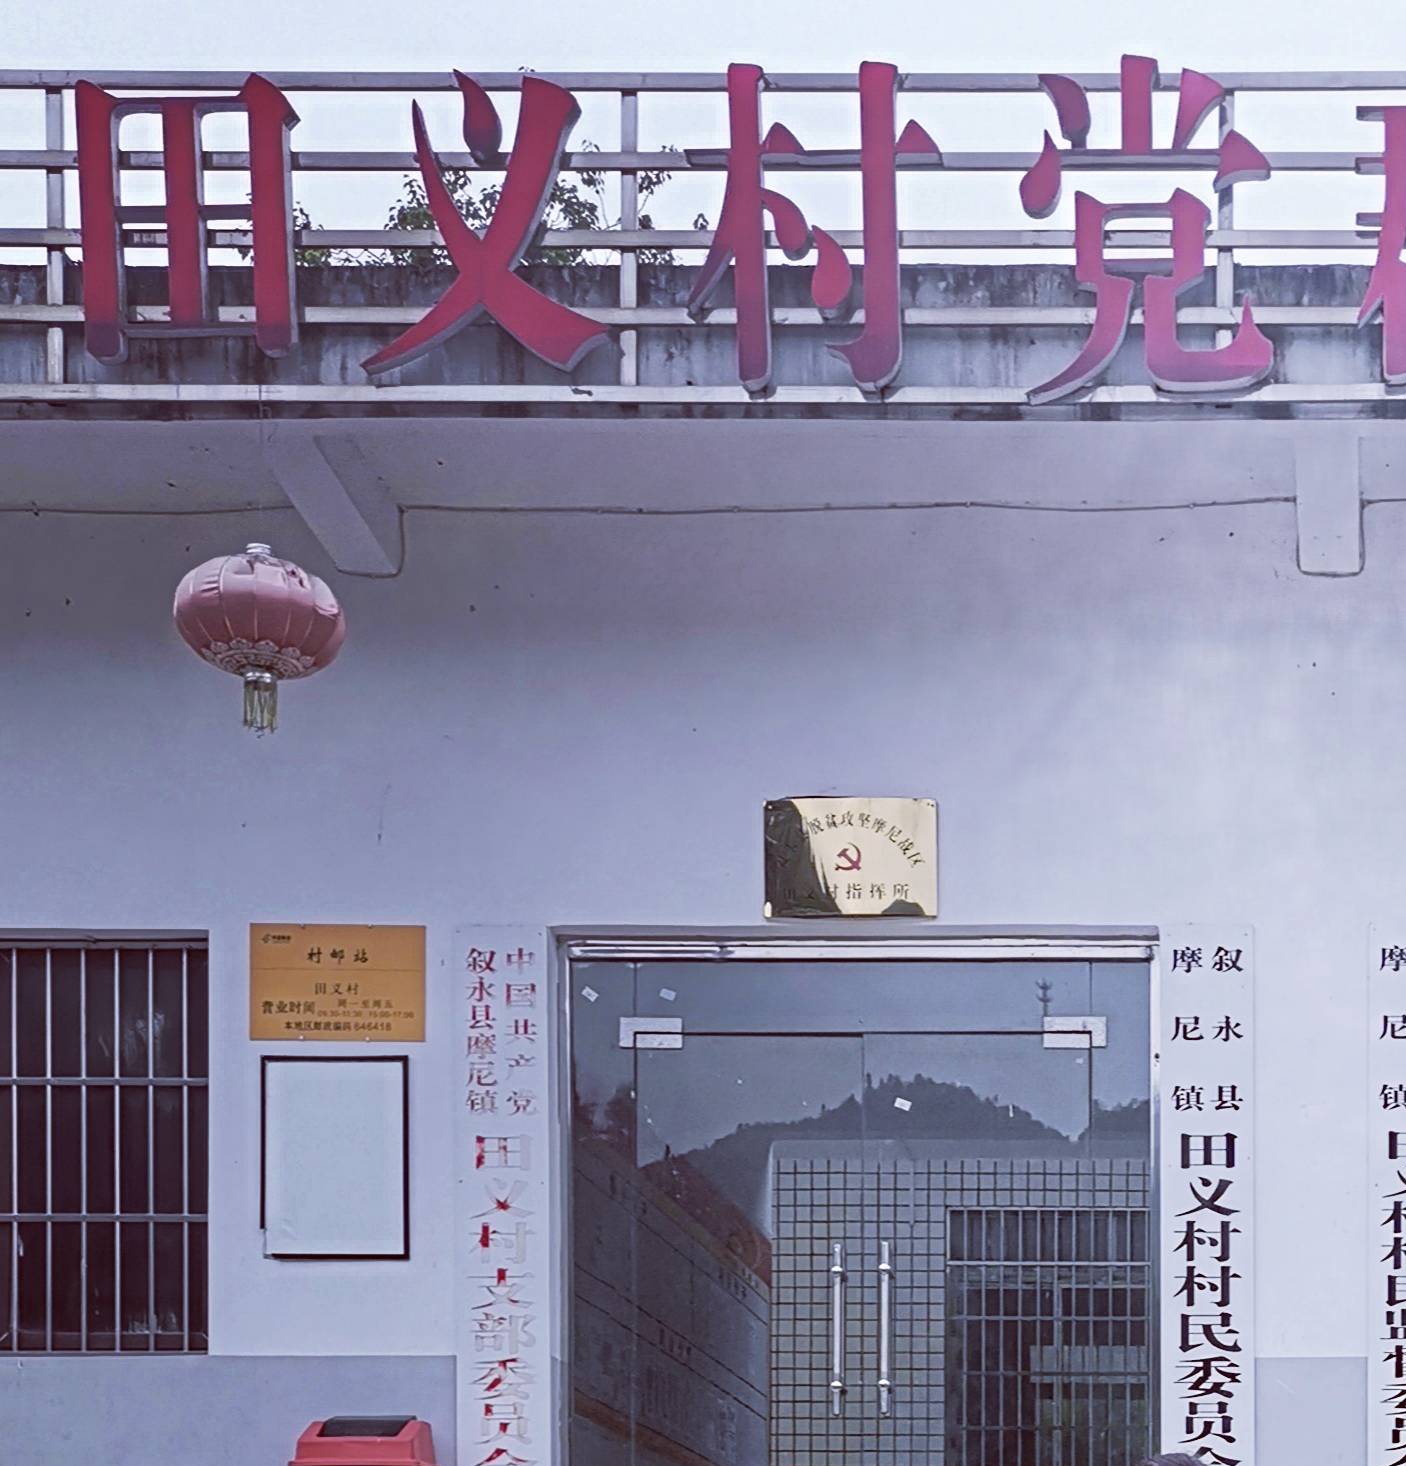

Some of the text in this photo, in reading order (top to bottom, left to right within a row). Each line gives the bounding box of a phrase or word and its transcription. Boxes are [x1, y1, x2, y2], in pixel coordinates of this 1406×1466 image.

[261, 1000, 316, 1015] 营业时间
[306, 947, 369, 964] 村邮站
[314, 982, 359, 996] 田义村
[465, 947, 497, 1115] 叙永县摩尼镇
[505, 947, 537, 1117] 中国共产党
[1171, 946, 1205, 1112] 摩尼镇
[1210, 946, 1244, 1111] 叙永县
